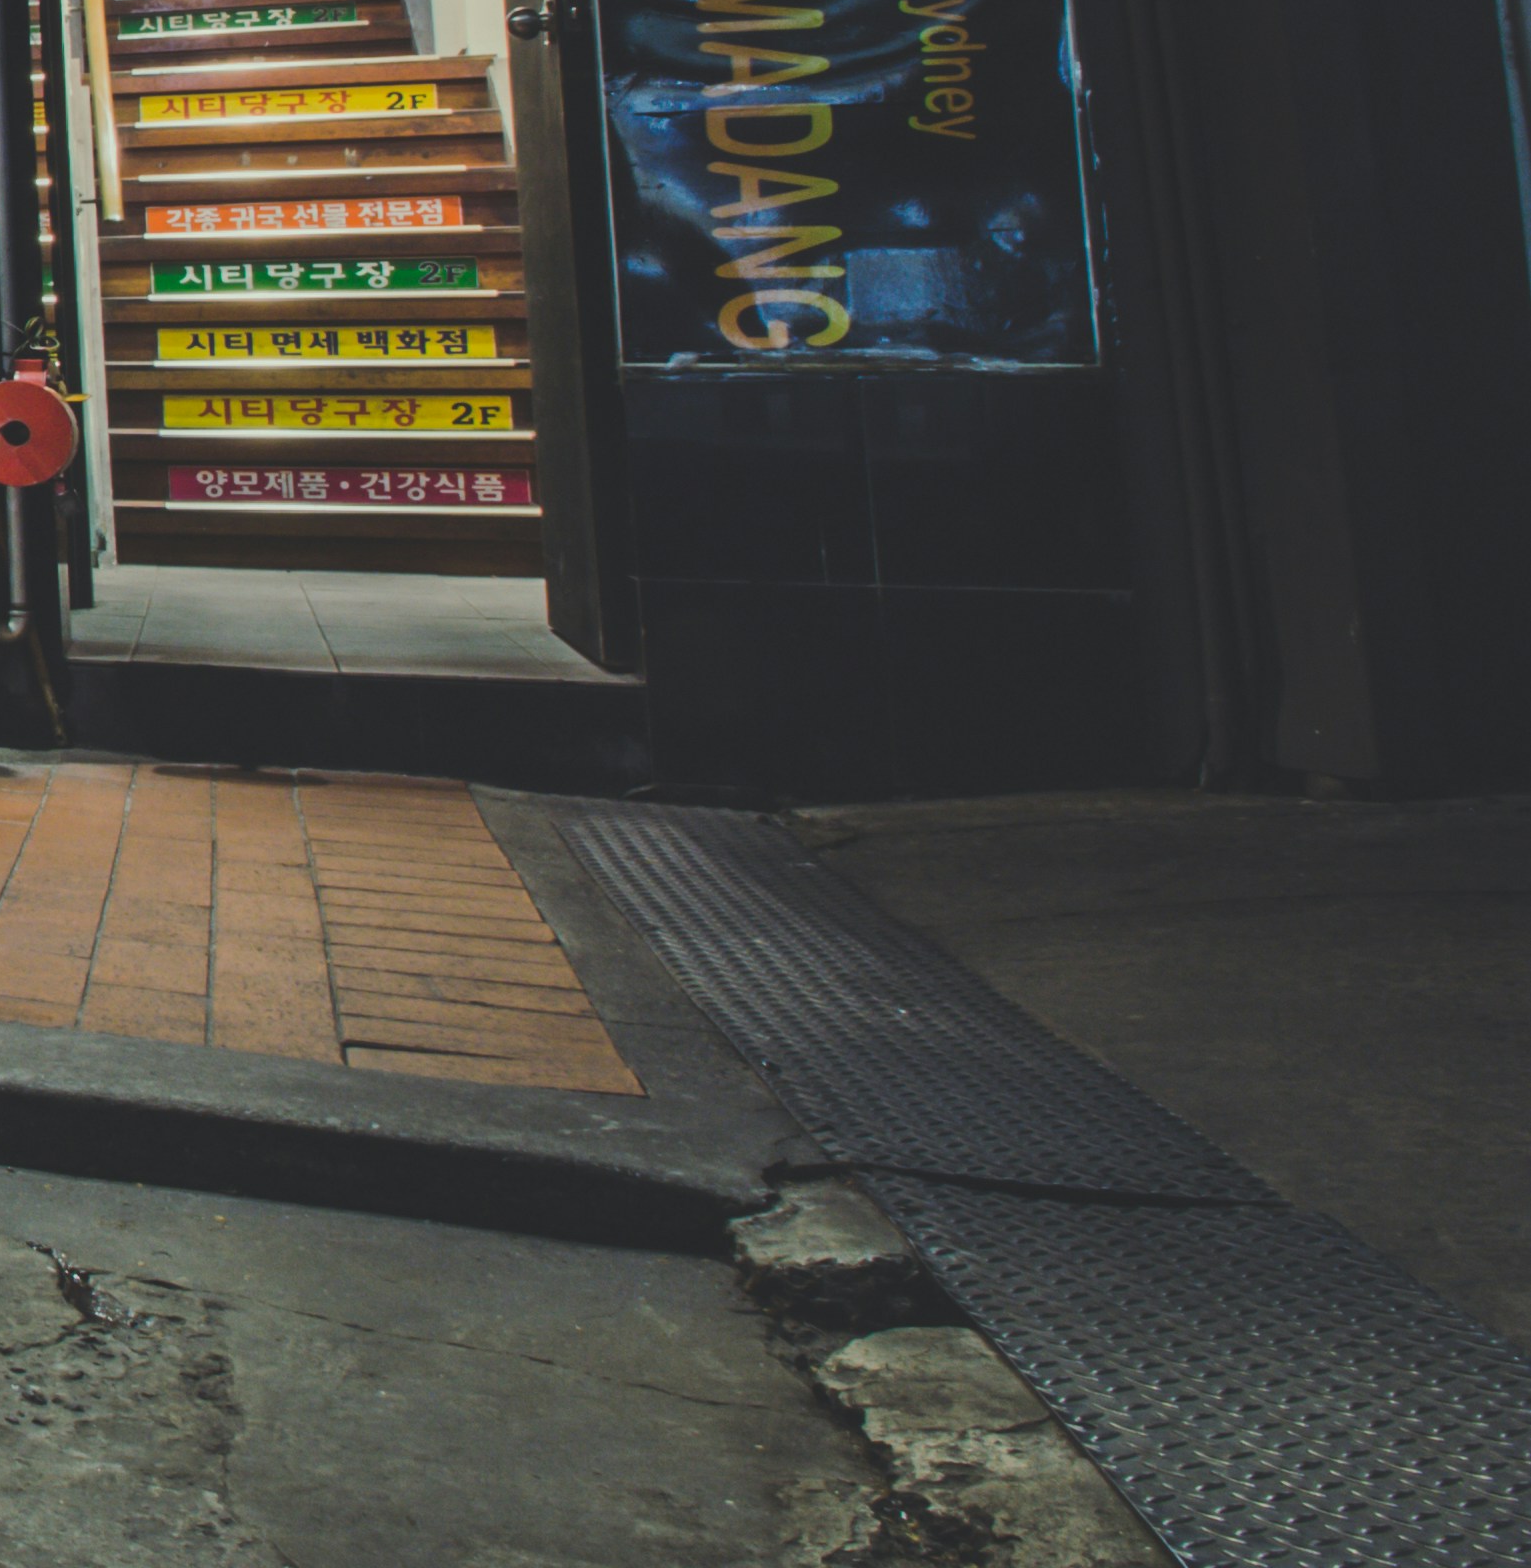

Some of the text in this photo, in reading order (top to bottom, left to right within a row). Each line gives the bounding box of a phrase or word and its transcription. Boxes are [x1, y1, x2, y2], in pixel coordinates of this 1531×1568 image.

[386, 91, 427, 112] 2F
[166, 207, 222, 234] 각종
[358, 197, 445, 227] 전문점
[418, 261, 467, 285] 2F
[185, 328, 471, 357] 시티 면세 백화점
[451, 402, 502, 426] 2F
